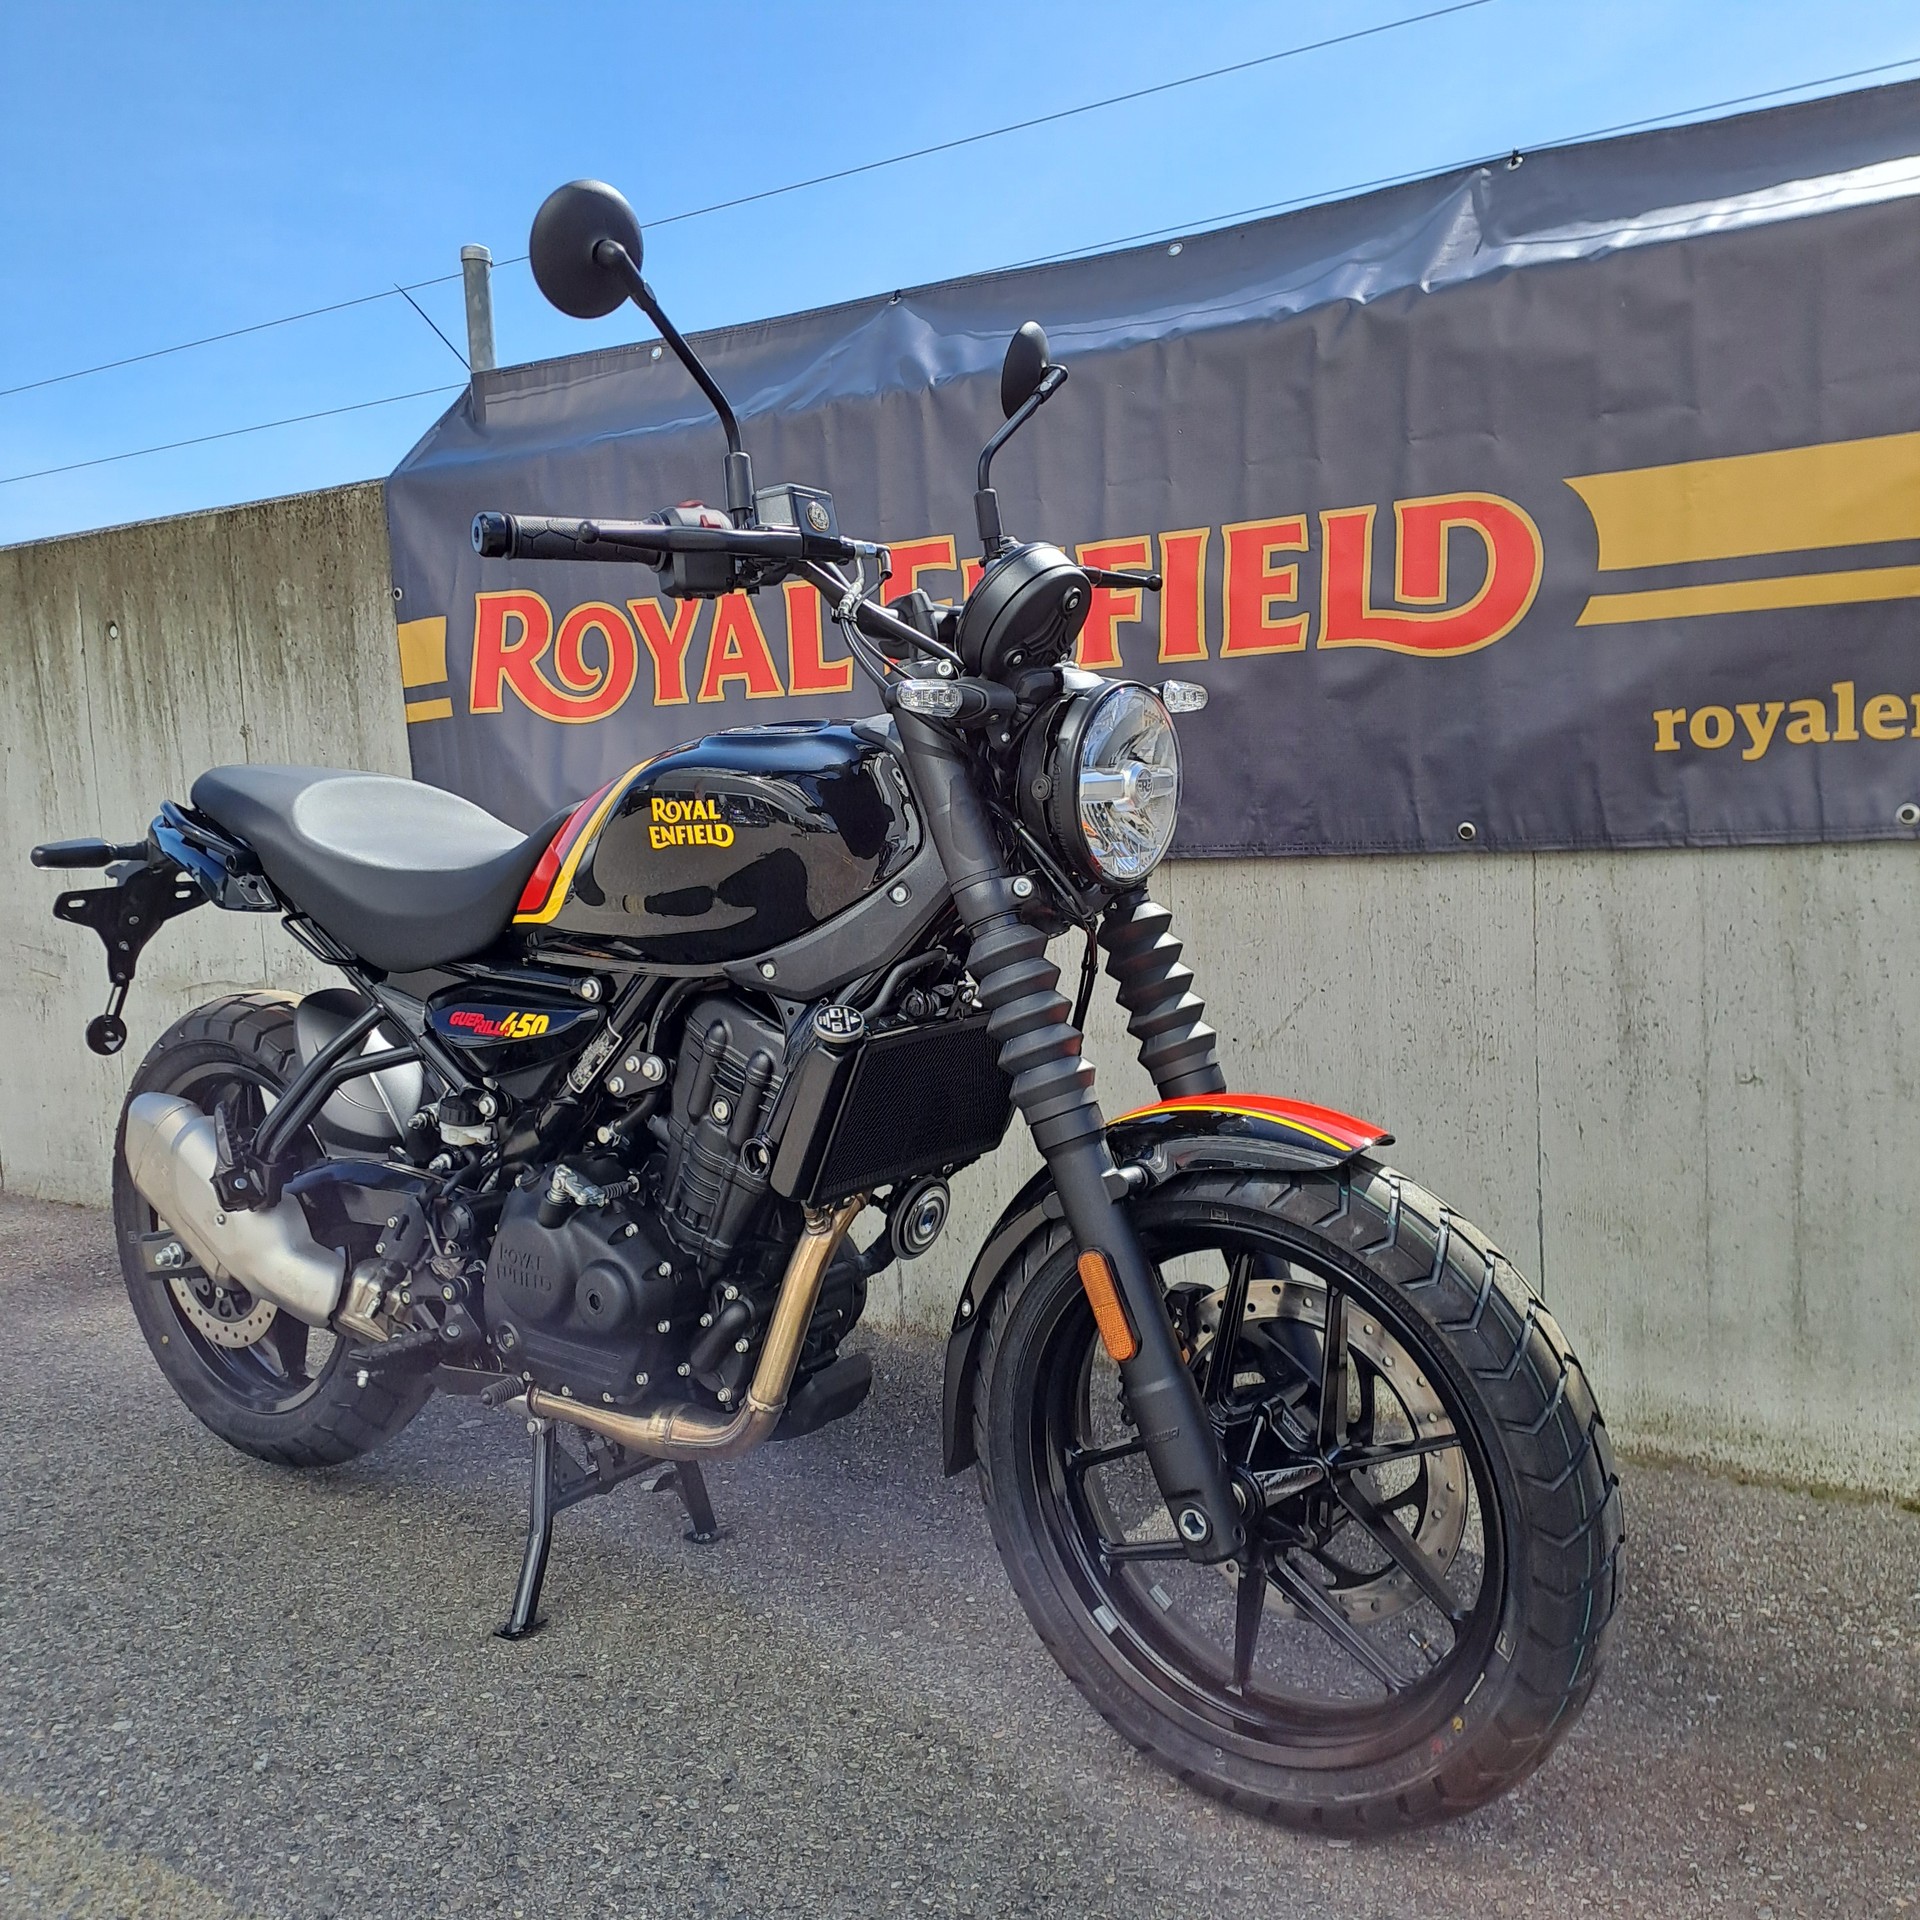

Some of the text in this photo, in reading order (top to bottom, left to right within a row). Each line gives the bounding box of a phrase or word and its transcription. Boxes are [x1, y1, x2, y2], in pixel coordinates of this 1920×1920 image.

[470, 491, 1545, 725] ROYAL EFIELD
[1653, 680, 1920, 761] royale
[651, 797, 721, 824] ROYAL
[648, 823, 735, 849] ENFIELD
[500, 1011, 550, 1038] 450
